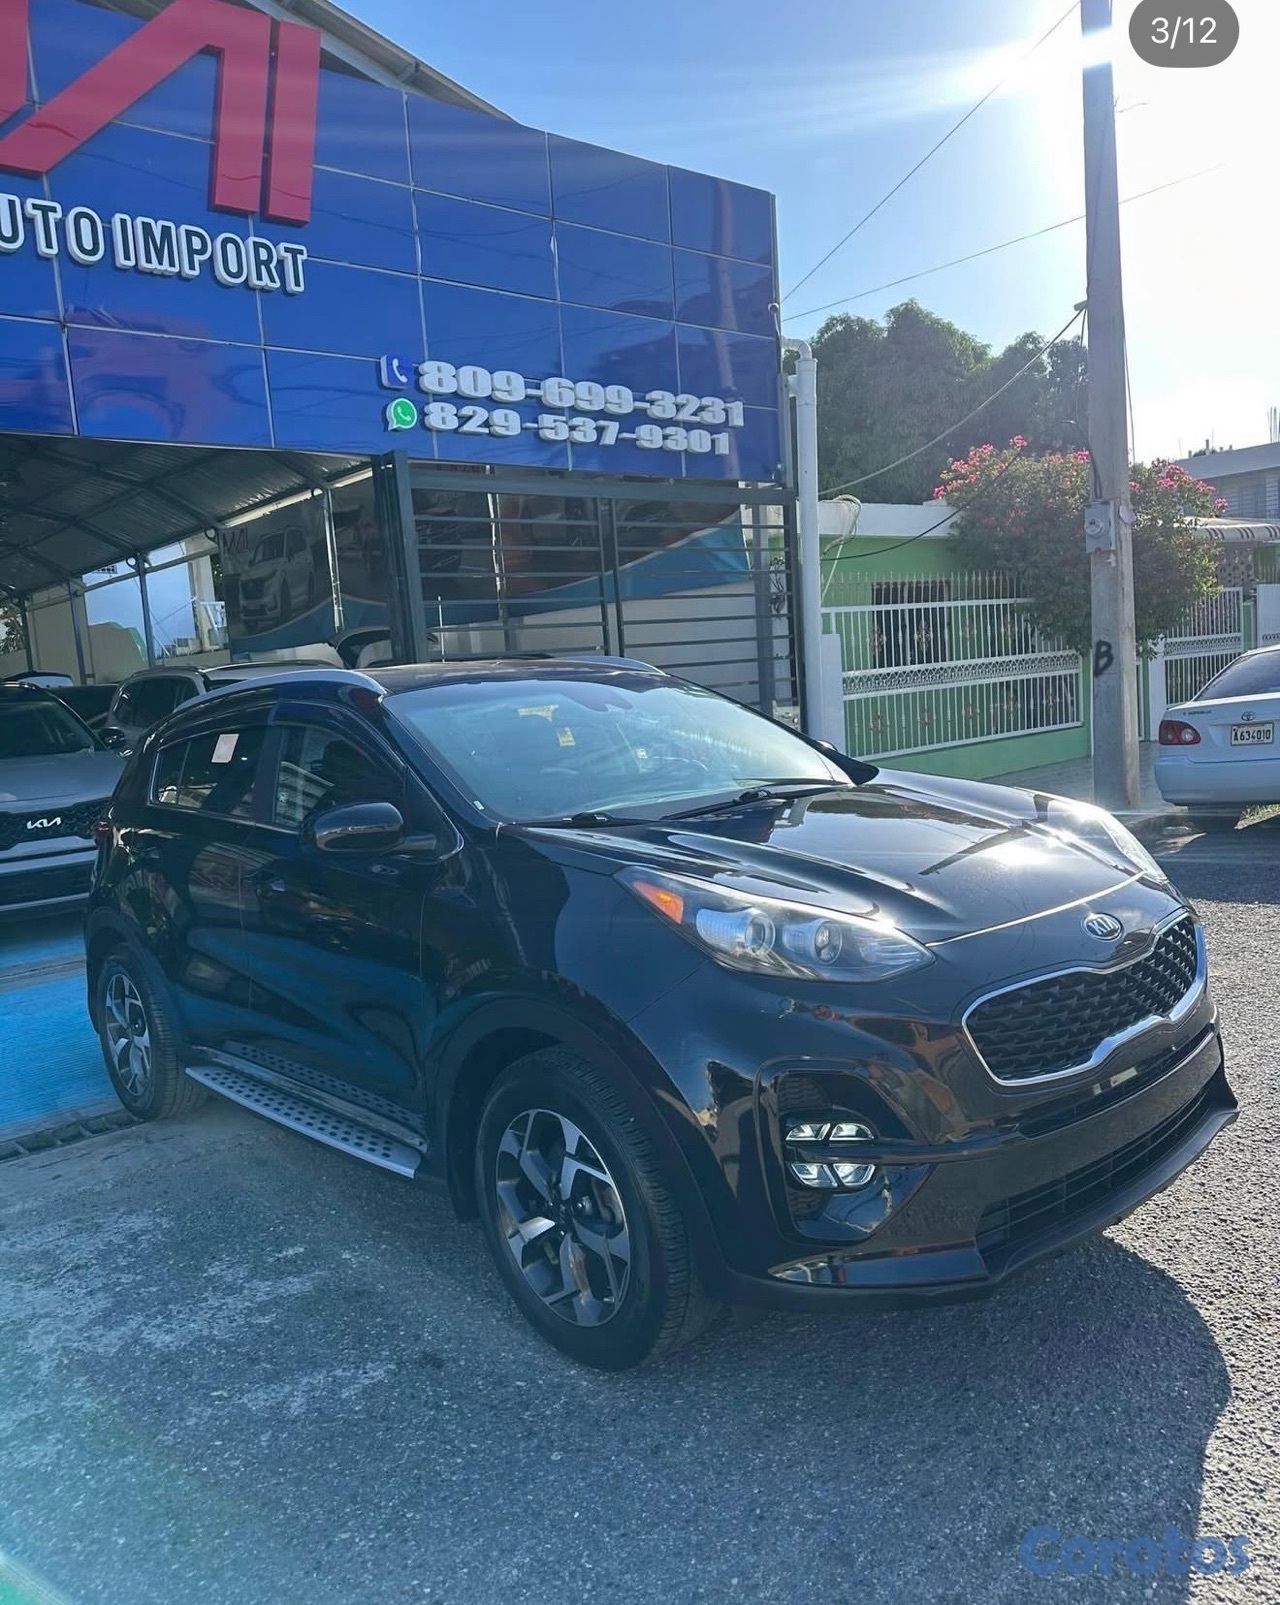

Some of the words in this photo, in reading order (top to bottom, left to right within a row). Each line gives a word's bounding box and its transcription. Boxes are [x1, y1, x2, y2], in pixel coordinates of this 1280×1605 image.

[111, 212, 307, 293] IMPORT
[418, 360, 744, 427] 809-699-3231
[424, 402, 730, 455] 829-537-9301
[1093, 639, 1114, 678] B
[1232, 726, 1272, 742] A634010
[26, 816, 62, 829] KIA
[1087, 916, 1119, 936] KIA
